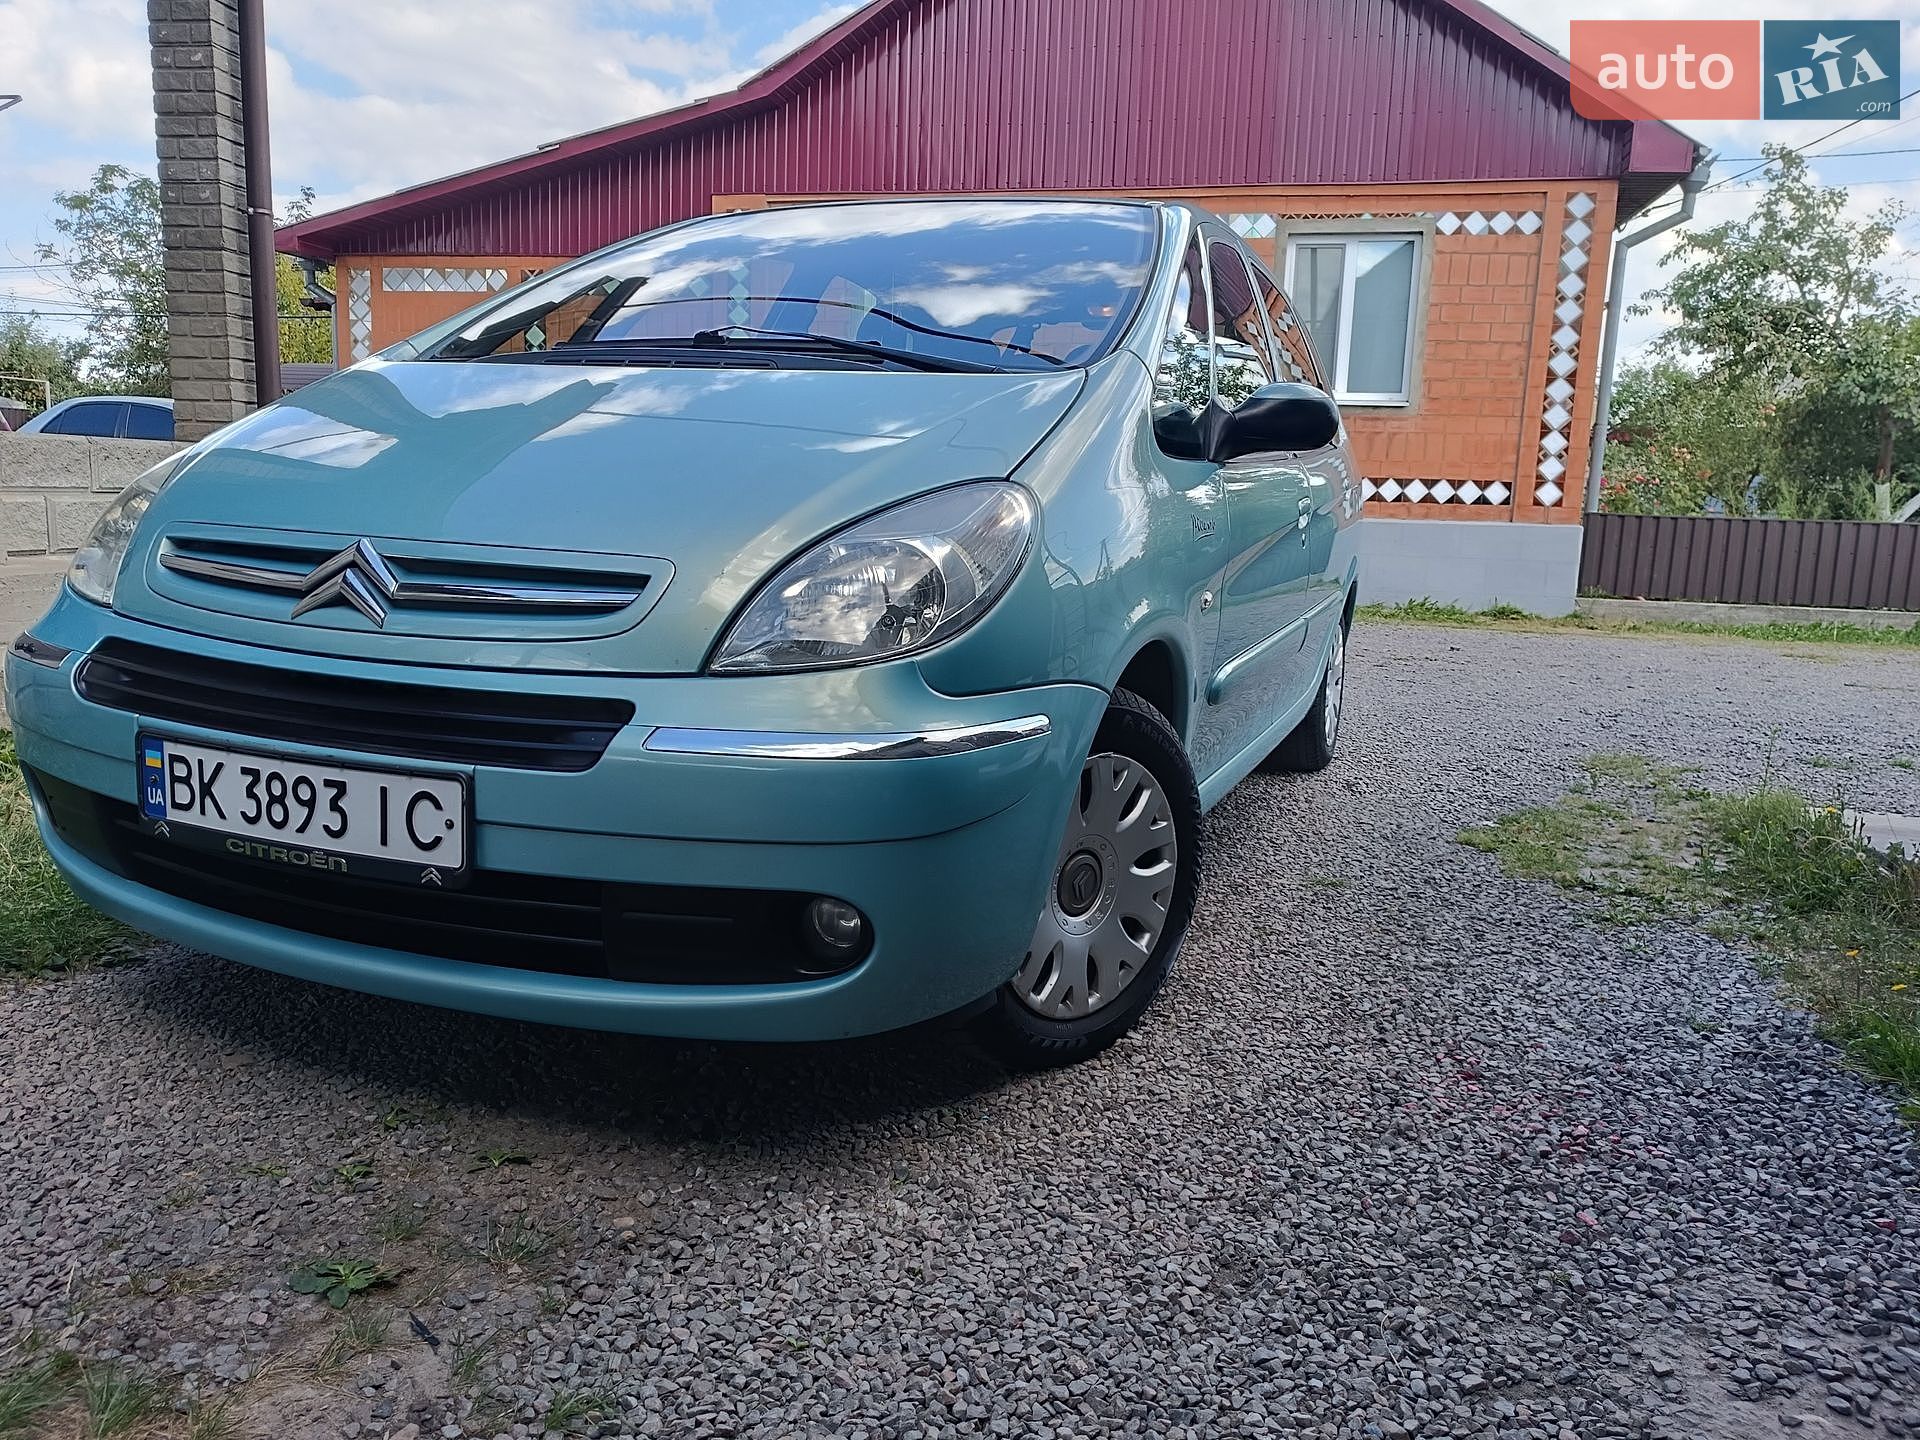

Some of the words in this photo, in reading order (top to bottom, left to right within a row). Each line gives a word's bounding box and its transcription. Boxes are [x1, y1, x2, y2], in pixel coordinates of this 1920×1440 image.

[147, 786, 164, 807] UA
[167, 752, 227, 820] BK
[239, 766, 350, 839] 3893
[379, 785, 444, 852] IC
